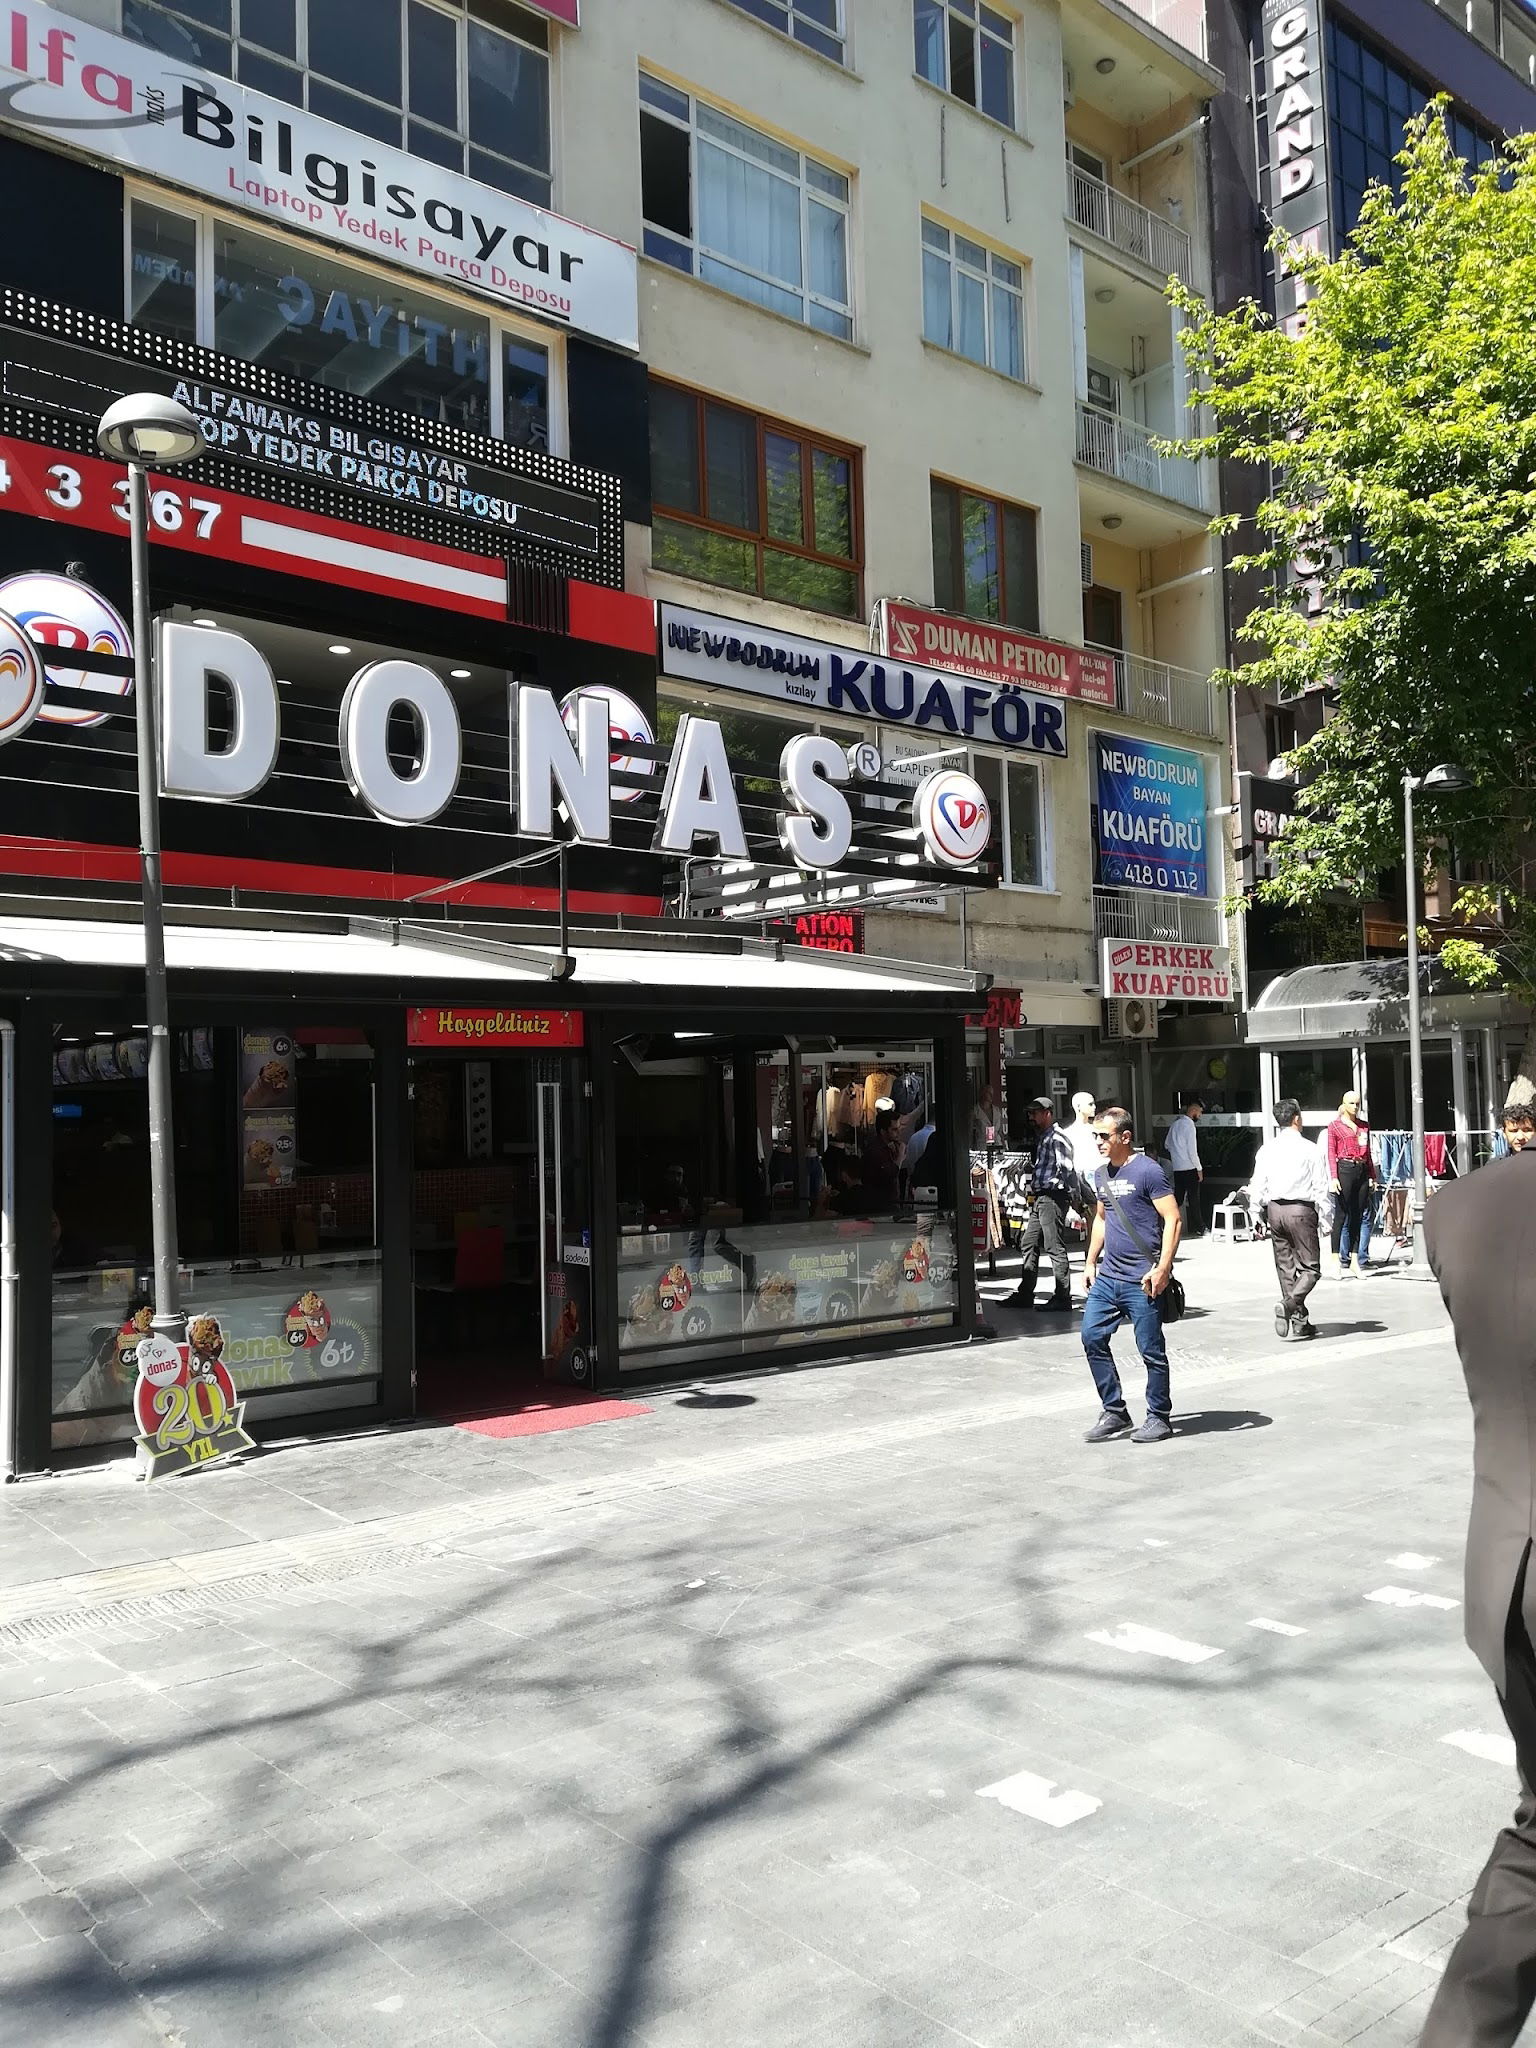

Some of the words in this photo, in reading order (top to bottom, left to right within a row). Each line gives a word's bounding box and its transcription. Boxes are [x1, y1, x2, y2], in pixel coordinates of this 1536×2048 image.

[136, 85, 165, 127] maks
[1270, 7, 1315, 204] GRAND
[181, 84, 584, 283] Bilgisayar
[228, 167, 323, 221] Laptop
[333, 206, 408, 252] Yedek
[418, 236, 481, 280] Parça
[490, 265, 572, 313] Deposu
[172, 380, 321, 443] ALFAMAKS
[243, 426, 334, 476] YEDEK
[341, 456, 421, 499] PARÇA
[428, 479, 519, 525] DEPOSU
[924, 621, 998, 665] DUMAN
[1002, 640, 1070, 682] PETROL
[1078, 654, 1108, 673] KAL-YAK
[667, 622, 820, 681] NEWBODRUM
[826, 653, 1066, 752] KUAFÖR
[785, 679, 817, 702] kızılay
[1081, 670, 1106, 686] fuel-oil
[1080, 687, 1109, 702] motorin
[152, 615, 852, 872] DONAS
[1101, 748, 1198, 788] NEWBODRUM
[1133, 785, 1171, 805] BAYAN
[1102, 808, 1202, 852] KUAFÖRÜ
[1125, 863, 1153, 885] 418
[1157, 867, 1168, 887] 0
[1172, 869, 1198, 890] 112
[1135, 944, 1215, 970] ERKEK
[1112, 970, 1229, 998] KUAFÖRÜ
[438, 1010, 550, 1038] Hoşgeldiniz
[565, 1252, 589, 1264] sodexo
[788, 1253, 819, 1271] donas
[698, 1264, 733, 1285] tavuk
[147, 1358, 178, 1378] donas
[234, 1361, 295, 1389] avuk
[153, 1377, 227, 1451] 20
[182, 1436, 220, 1464] YIL
